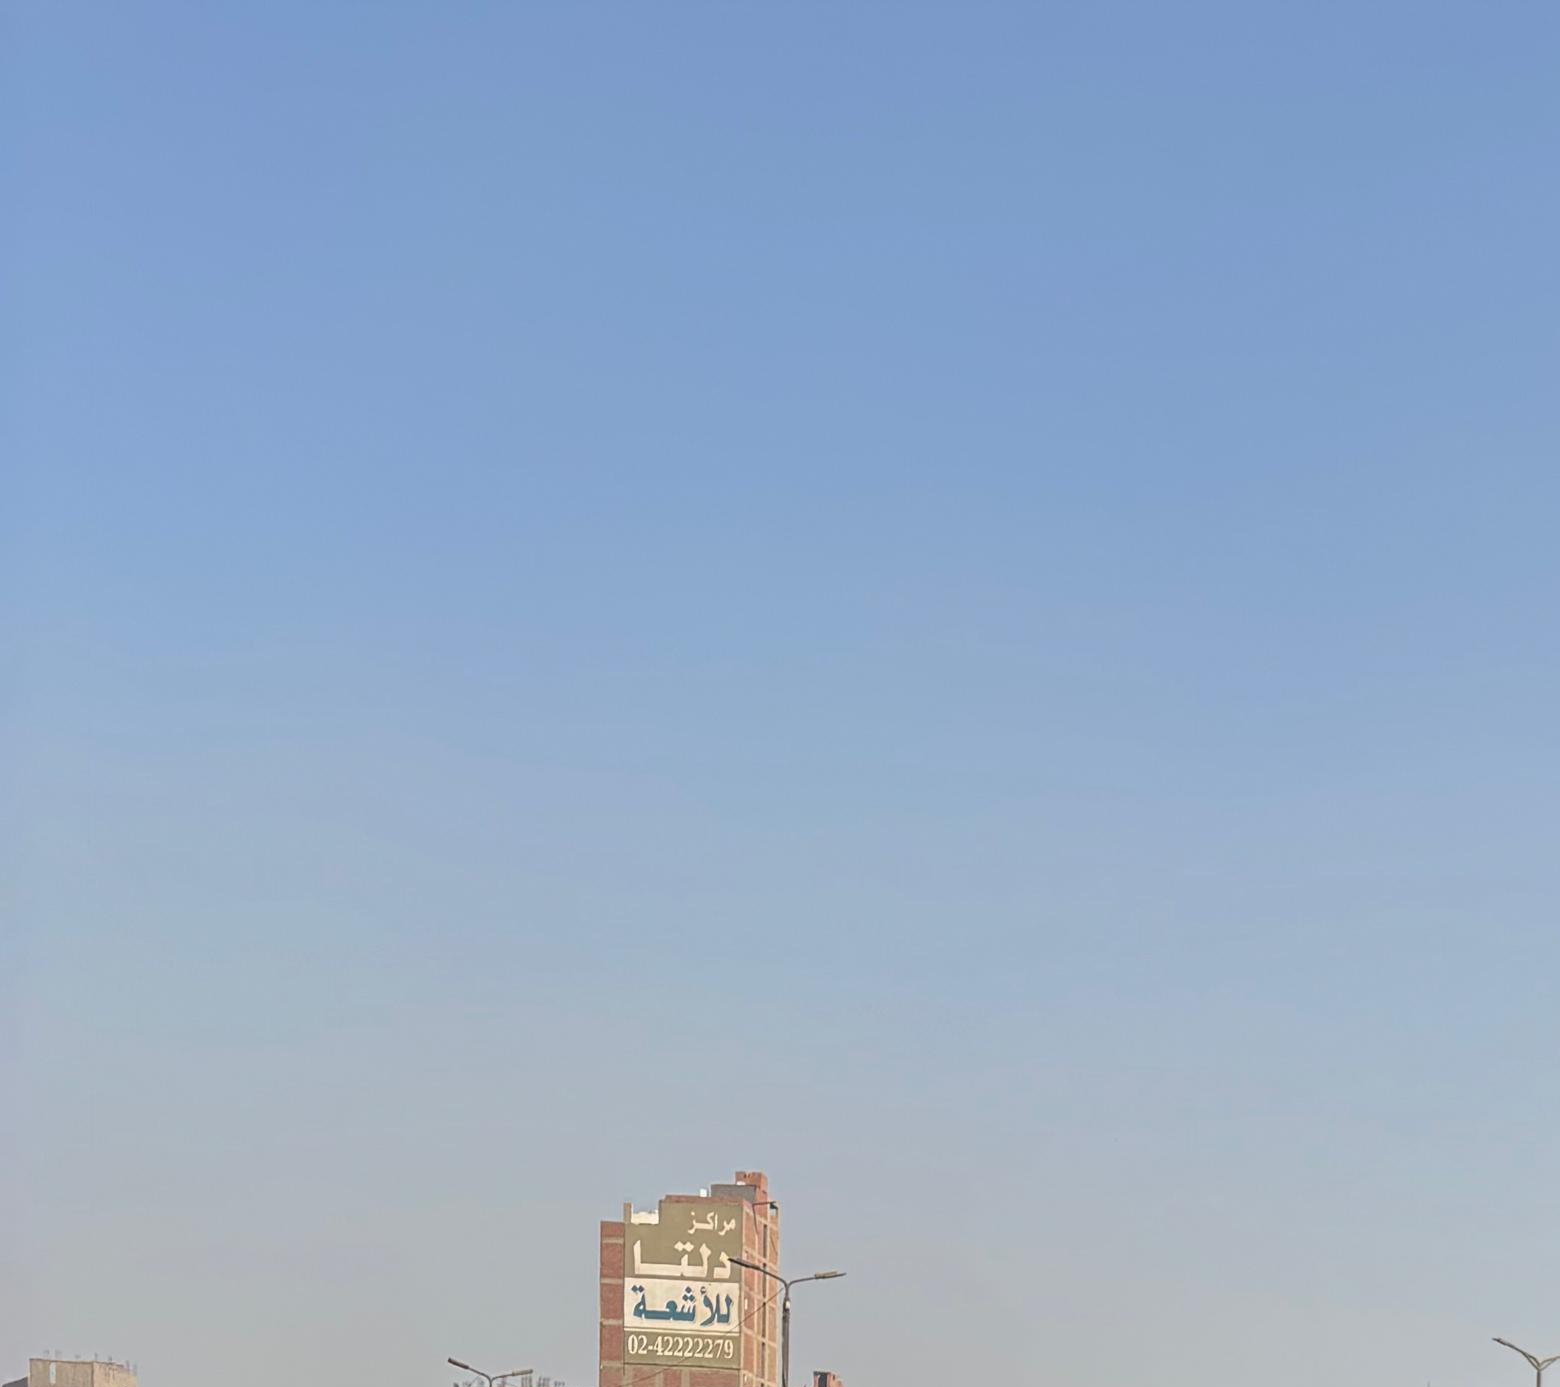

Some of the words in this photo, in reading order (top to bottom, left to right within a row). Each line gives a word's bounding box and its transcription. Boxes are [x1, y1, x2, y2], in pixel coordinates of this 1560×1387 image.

[688, 1211, 736, 1235] مراكز
[633, 1239, 731, 1279] دلتا
[631, 1284, 733, 1327] للأشعة
[628, 1334, 734, 1359] 02-42222279
